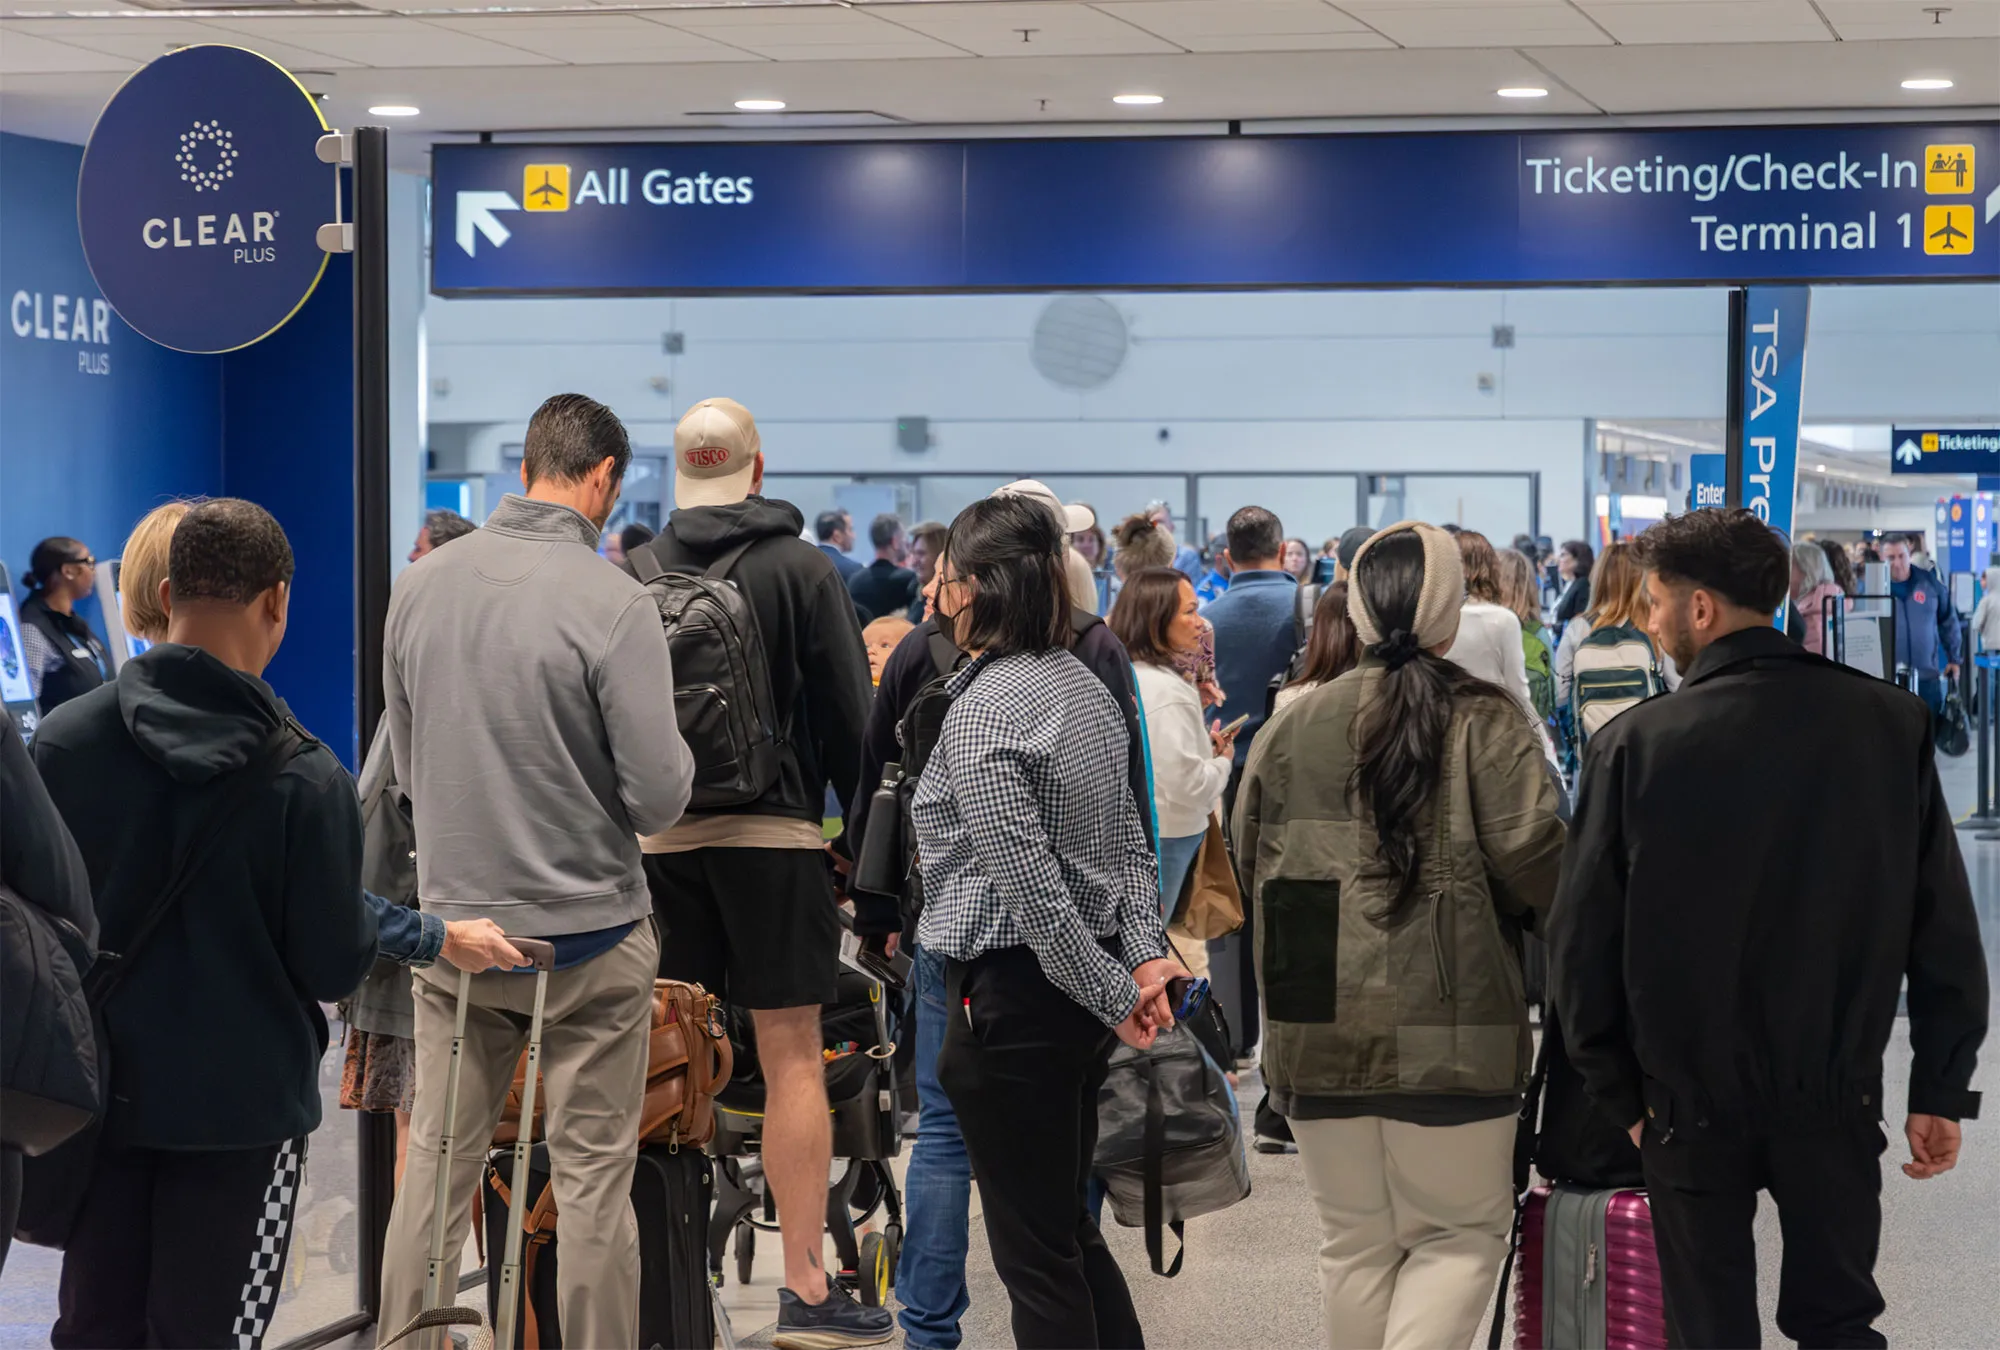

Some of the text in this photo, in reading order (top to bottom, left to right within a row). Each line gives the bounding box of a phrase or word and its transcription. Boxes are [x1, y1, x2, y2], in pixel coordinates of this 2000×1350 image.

[574, 167, 754, 205] All Gates
[1526, 151, 1918, 202] Ticketing/Check-In
[1691, 211, 1912, 251] Terminal 1
[233, 247, 276, 264] PLUS
[10, 289, 111, 346] CLEAR
[78, 350, 110, 376] PLUS
[1750, 308, 1780, 421] TSA
[687, 448, 727, 466] WISCO
[1939, 433, 2000, 454] Ticketing
[1696, 482, 1725, 505] Enter
